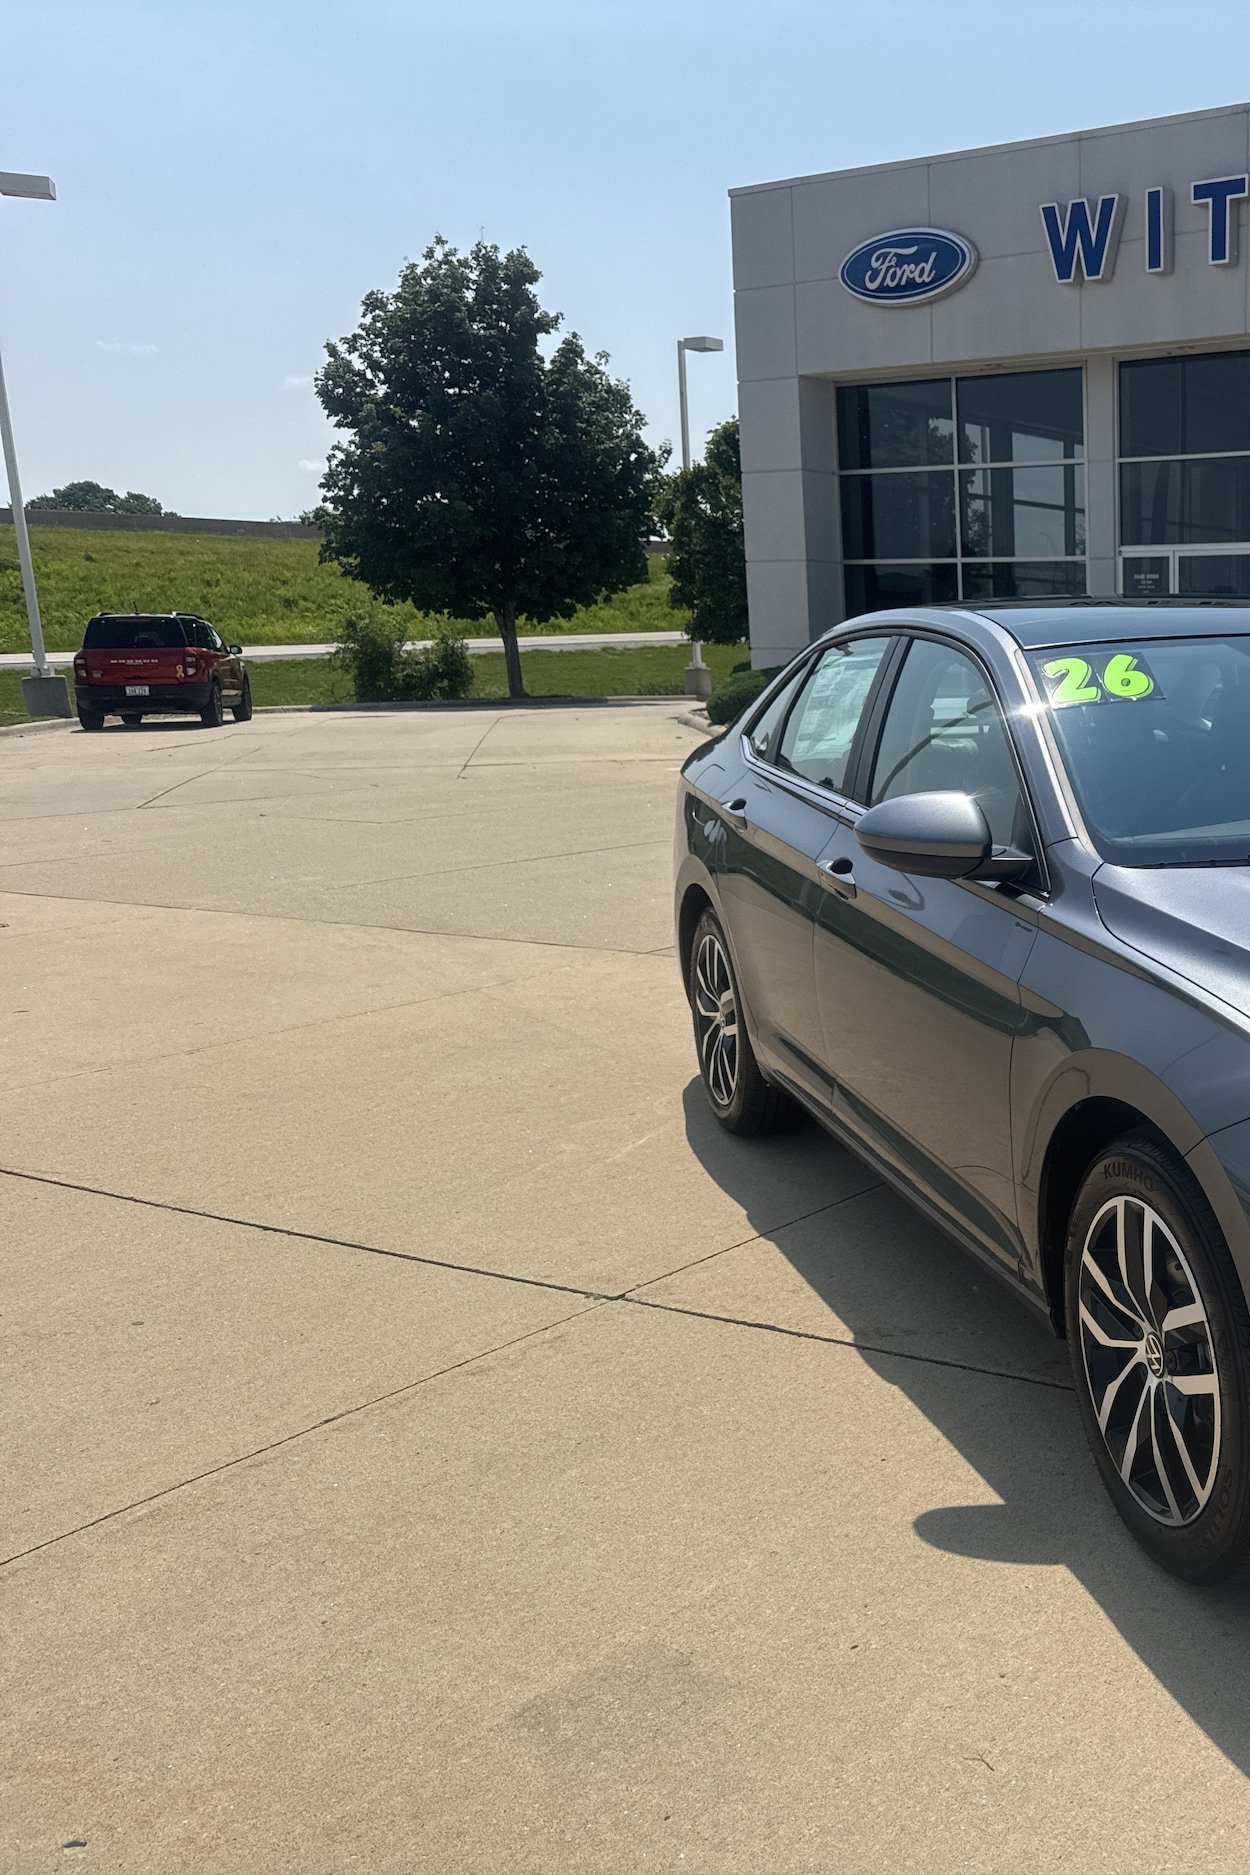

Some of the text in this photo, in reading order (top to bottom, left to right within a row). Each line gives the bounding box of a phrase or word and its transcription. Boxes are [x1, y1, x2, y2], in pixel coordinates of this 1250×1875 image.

[864, 245, 937, 291] Ford
[1041, 652, 1154, 704] 26
[1103, 1161, 1155, 1193] KUMHO
